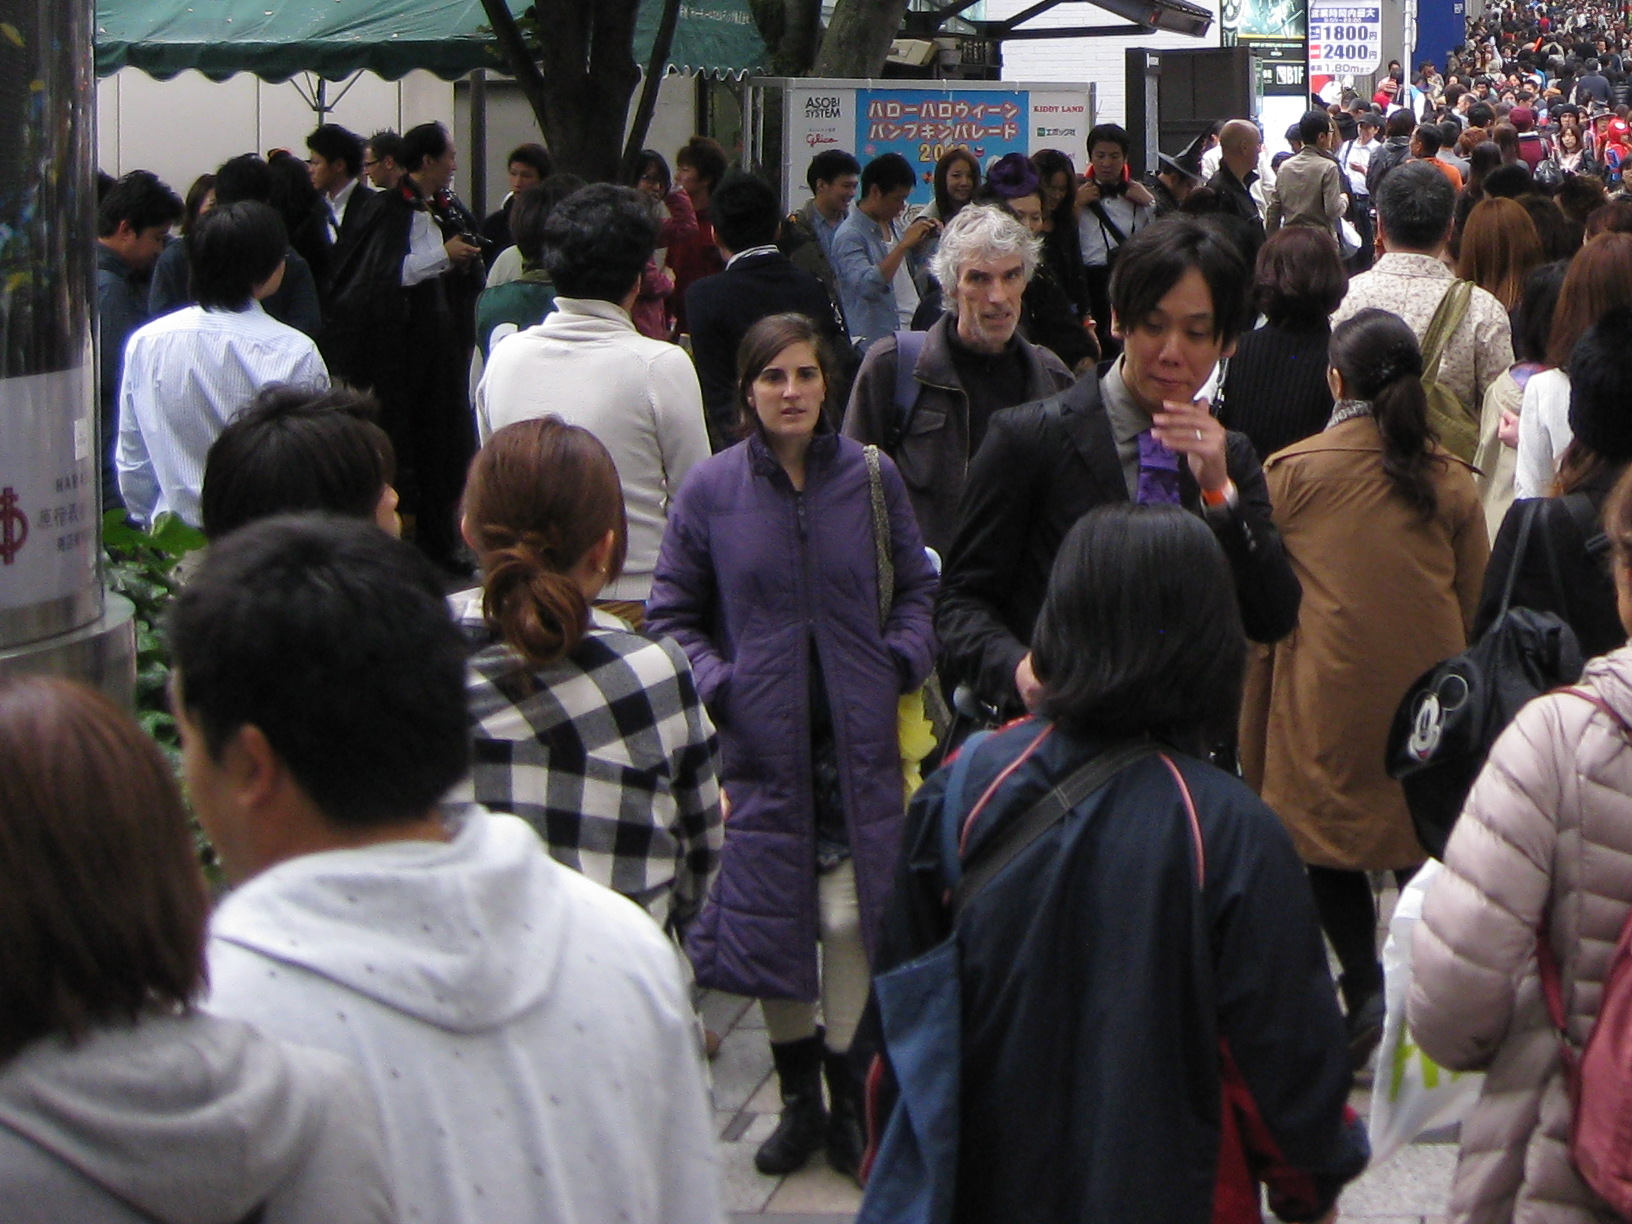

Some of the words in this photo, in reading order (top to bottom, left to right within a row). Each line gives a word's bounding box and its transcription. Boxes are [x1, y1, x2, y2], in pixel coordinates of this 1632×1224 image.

[805, 96, 840, 109] ASOBI
[805, 108, 841, 118] SYSTEM
[868, 102, 1019, 119] ハローハロウィーン
[1062, 105, 1084, 113] LAND
